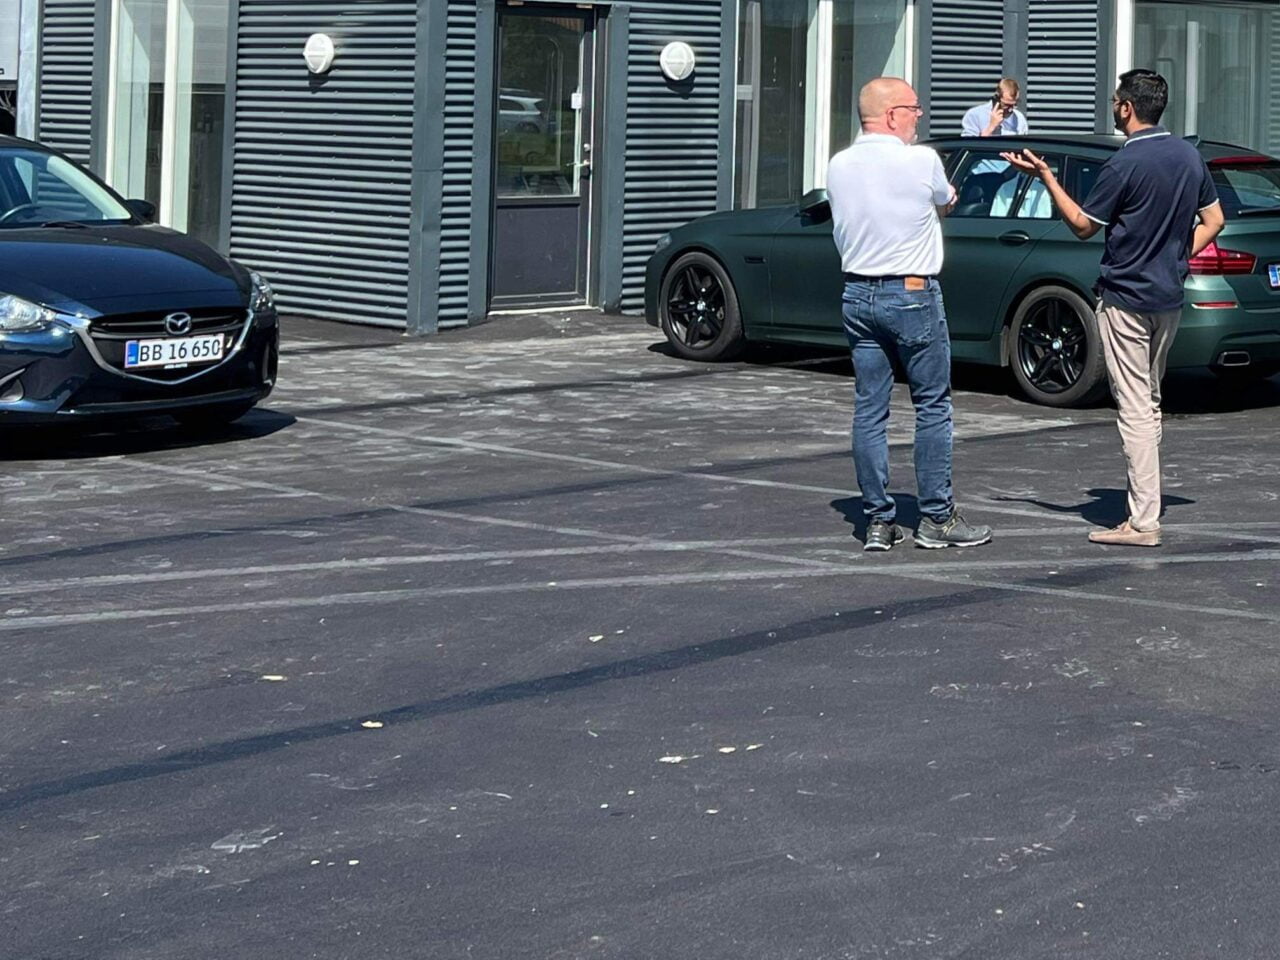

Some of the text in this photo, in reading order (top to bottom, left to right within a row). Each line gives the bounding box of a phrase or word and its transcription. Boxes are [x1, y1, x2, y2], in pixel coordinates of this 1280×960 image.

[140, 339, 220, 362] BB 16 650
